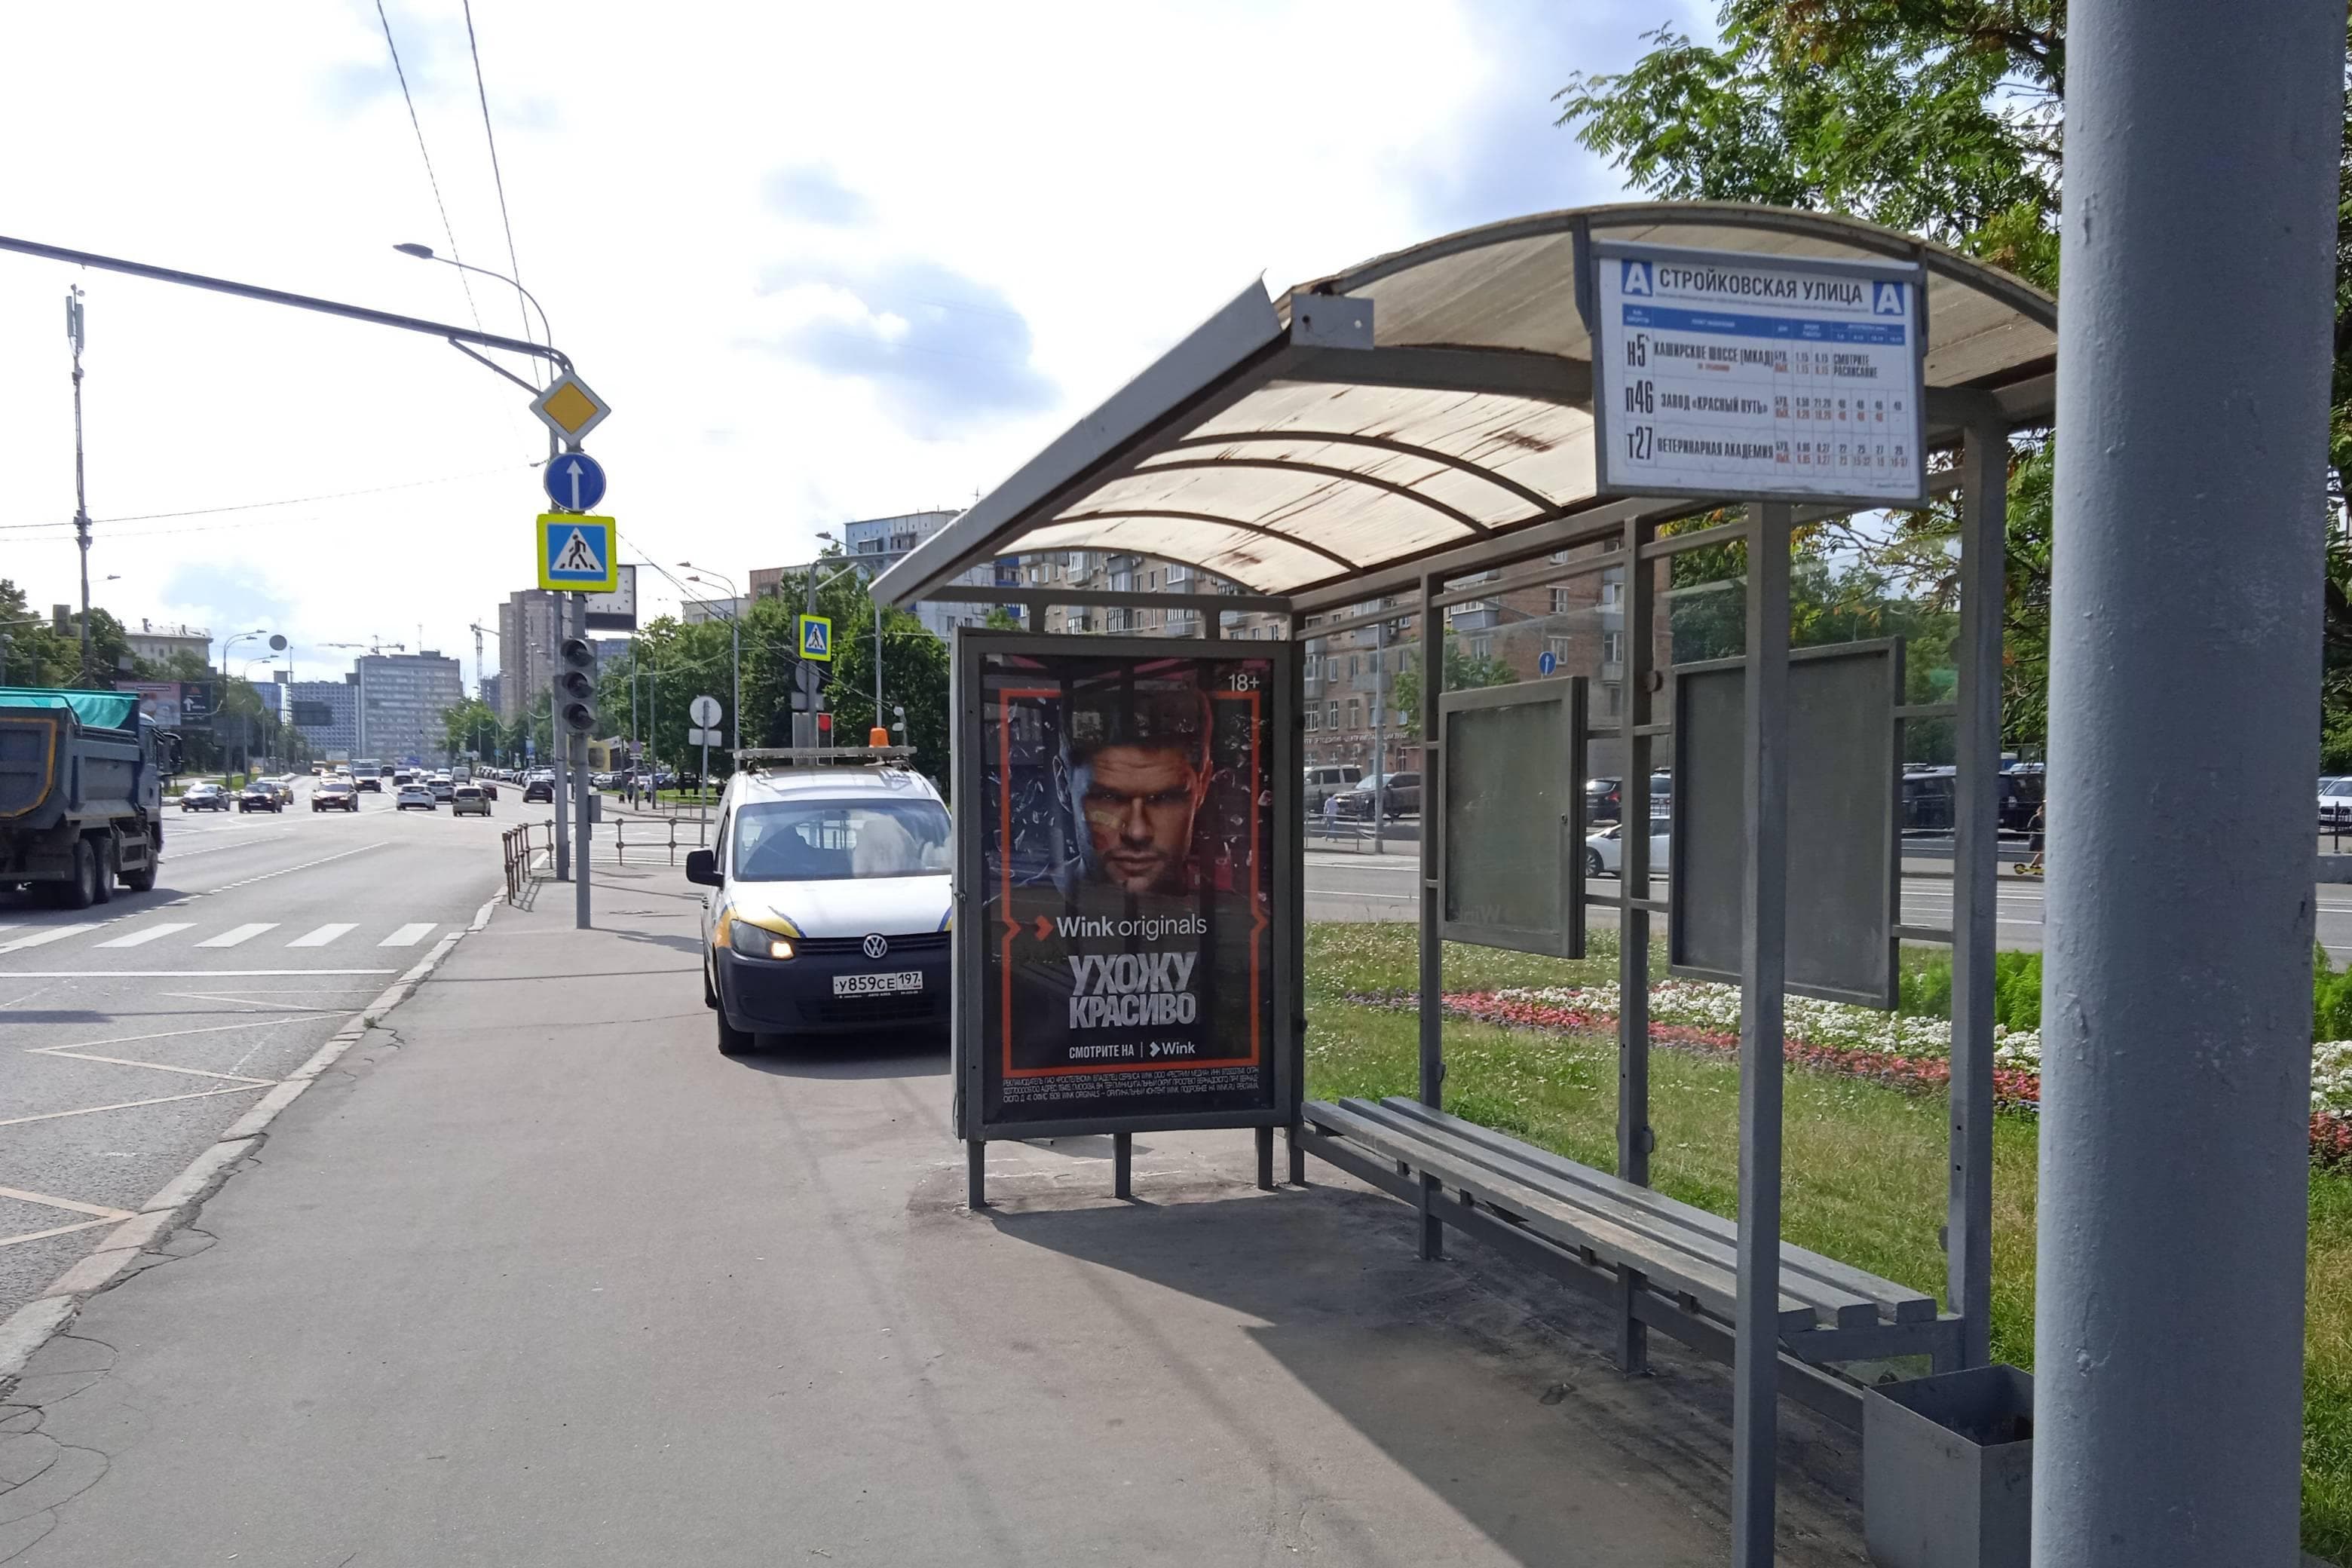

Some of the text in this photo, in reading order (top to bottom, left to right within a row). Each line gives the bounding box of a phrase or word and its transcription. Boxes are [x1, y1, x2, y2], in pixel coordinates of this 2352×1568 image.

[1660, 268, 1864, 305] СТРОЙКОВСКАЯ УЛИЦА
[1654, 341, 1707, 360] КАШИРСКОЕ
[1709, 346, 1739, 362] ШОССЕ
[1833, 354, 1870, 366] СМОТРИТЕ
[1833, 366, 1878, 378] РАСПИСАНИЕ
[1661, 393, 1690, 411] ЗАВОД
[1657, 437, 1774, 459] ВЕТЕРИНАРНАЯ АКАДЕМИЯ
[1229, 674, 1260, 692] 18+
[1056, 914, 1207, 941] Wink originals
[898, 972, 919, 985] 197
[1067, 951, 1198, 996] УХОЖУ
[1069, 992, 1196, 1029] КРАСИВО
[1069, 1043, 1135, 1059] СМОТРИТЕ НА
[1162, 1041, 1196, 1055] Wink
